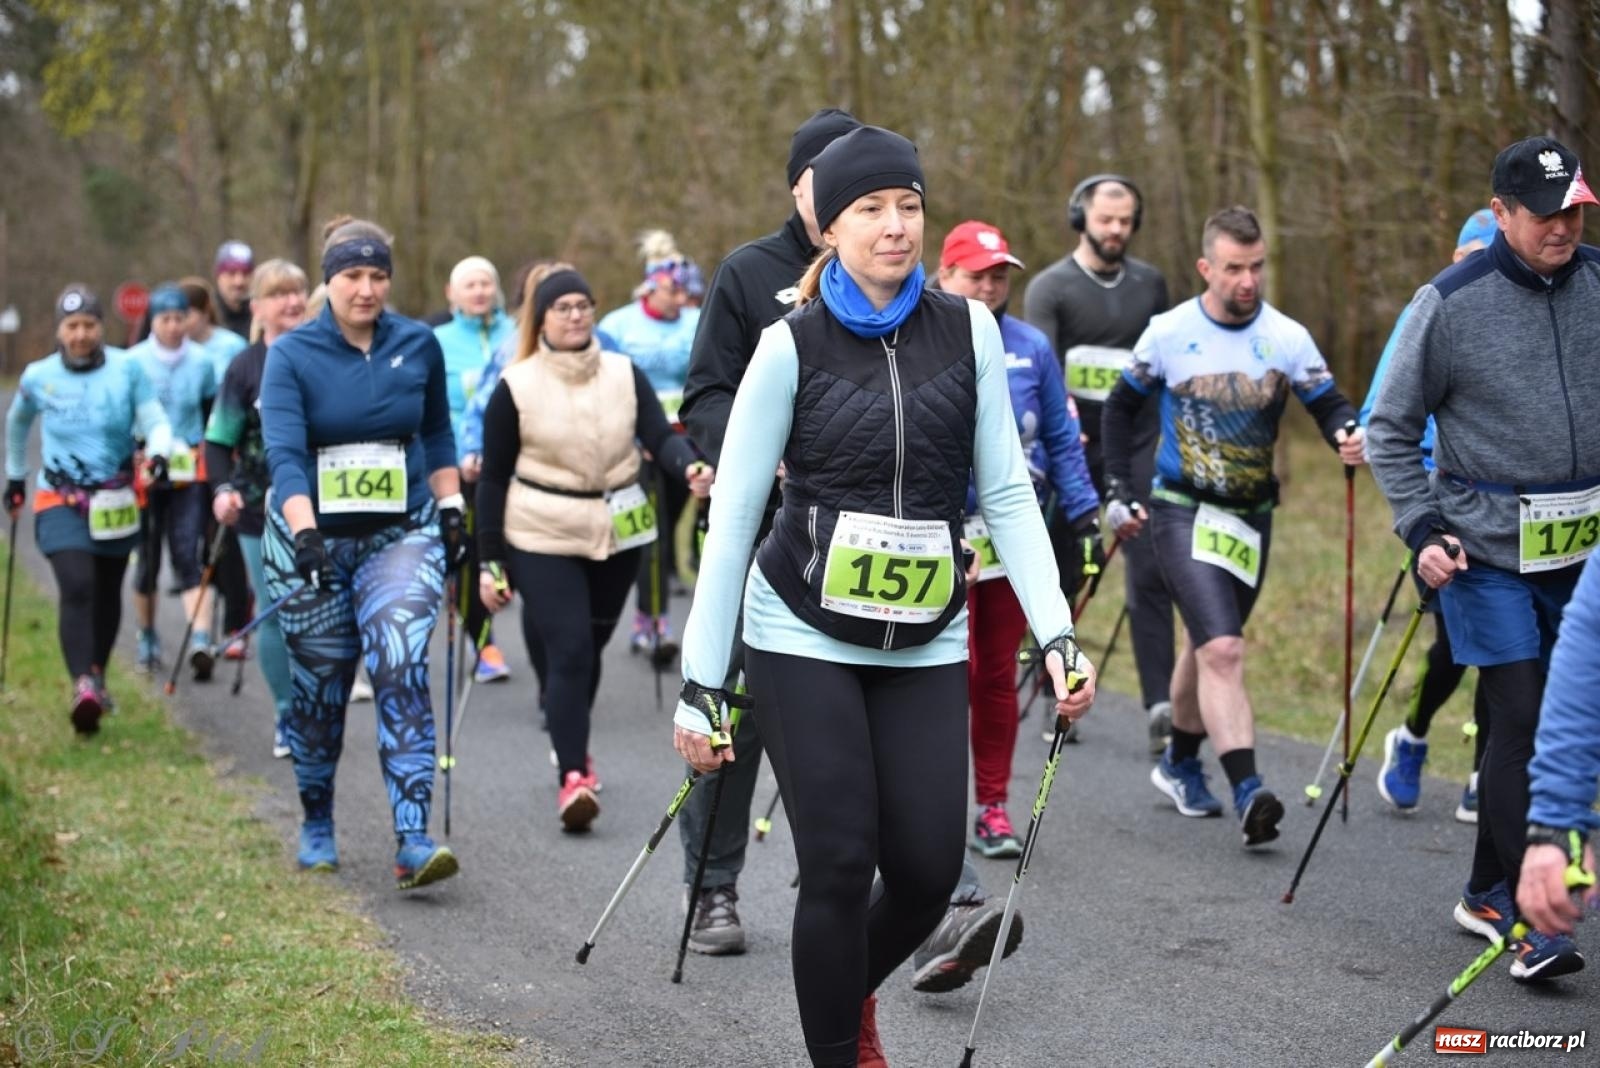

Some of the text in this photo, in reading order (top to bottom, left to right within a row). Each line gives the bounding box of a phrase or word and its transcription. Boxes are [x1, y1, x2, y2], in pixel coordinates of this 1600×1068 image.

[335, 470, 393, 498] 164
[1207, 531, 1250, 570] 174
[1538, 515, 1599, 556] 173
[848, 553, 940, 604] 157
